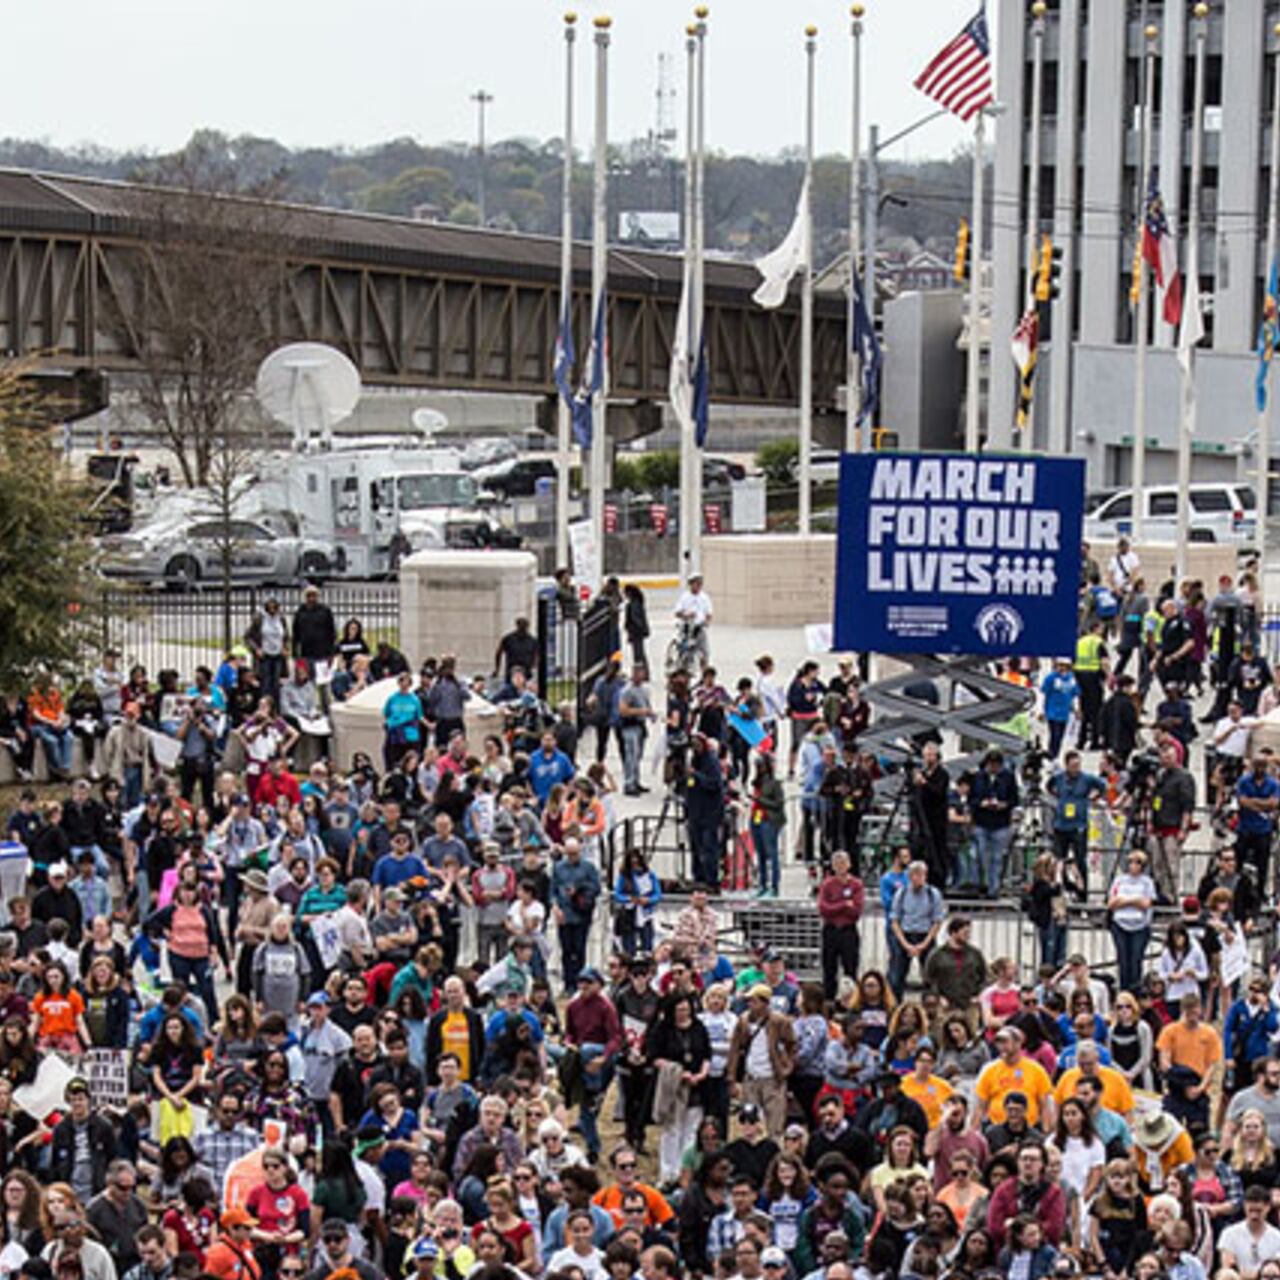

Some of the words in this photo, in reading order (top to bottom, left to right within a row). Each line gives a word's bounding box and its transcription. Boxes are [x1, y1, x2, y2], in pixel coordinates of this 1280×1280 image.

[870, 459, 1036, 503] MARCH
[867, 506, 958, 547] FOR
[964, 509, 1061, 551] OUR
[867, 551, 994, 595] LIVES
